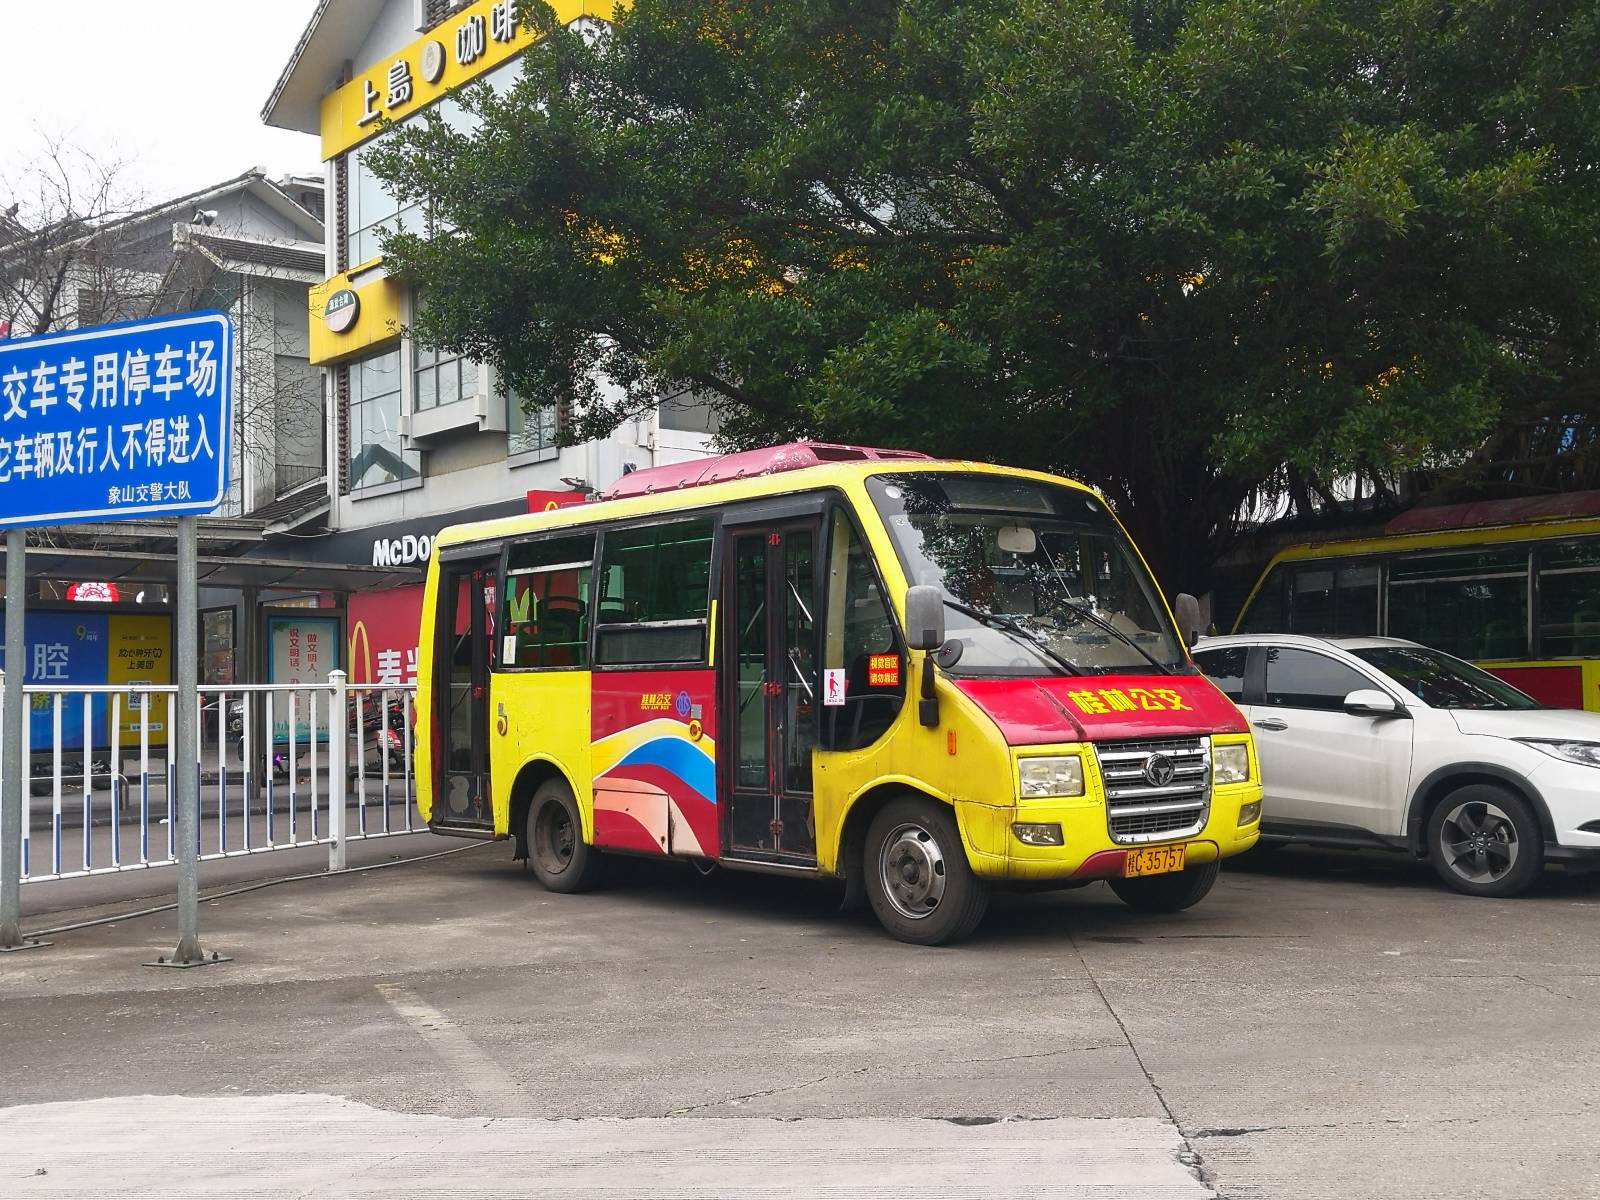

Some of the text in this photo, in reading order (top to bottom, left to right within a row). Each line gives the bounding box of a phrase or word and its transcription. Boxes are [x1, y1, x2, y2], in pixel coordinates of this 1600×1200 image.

[2, 339, 217, 421] 交车专用停车场
[108, 481, 191, 504] 象山交警大队
[1066, 688, 1194, 714] 桂林公交
